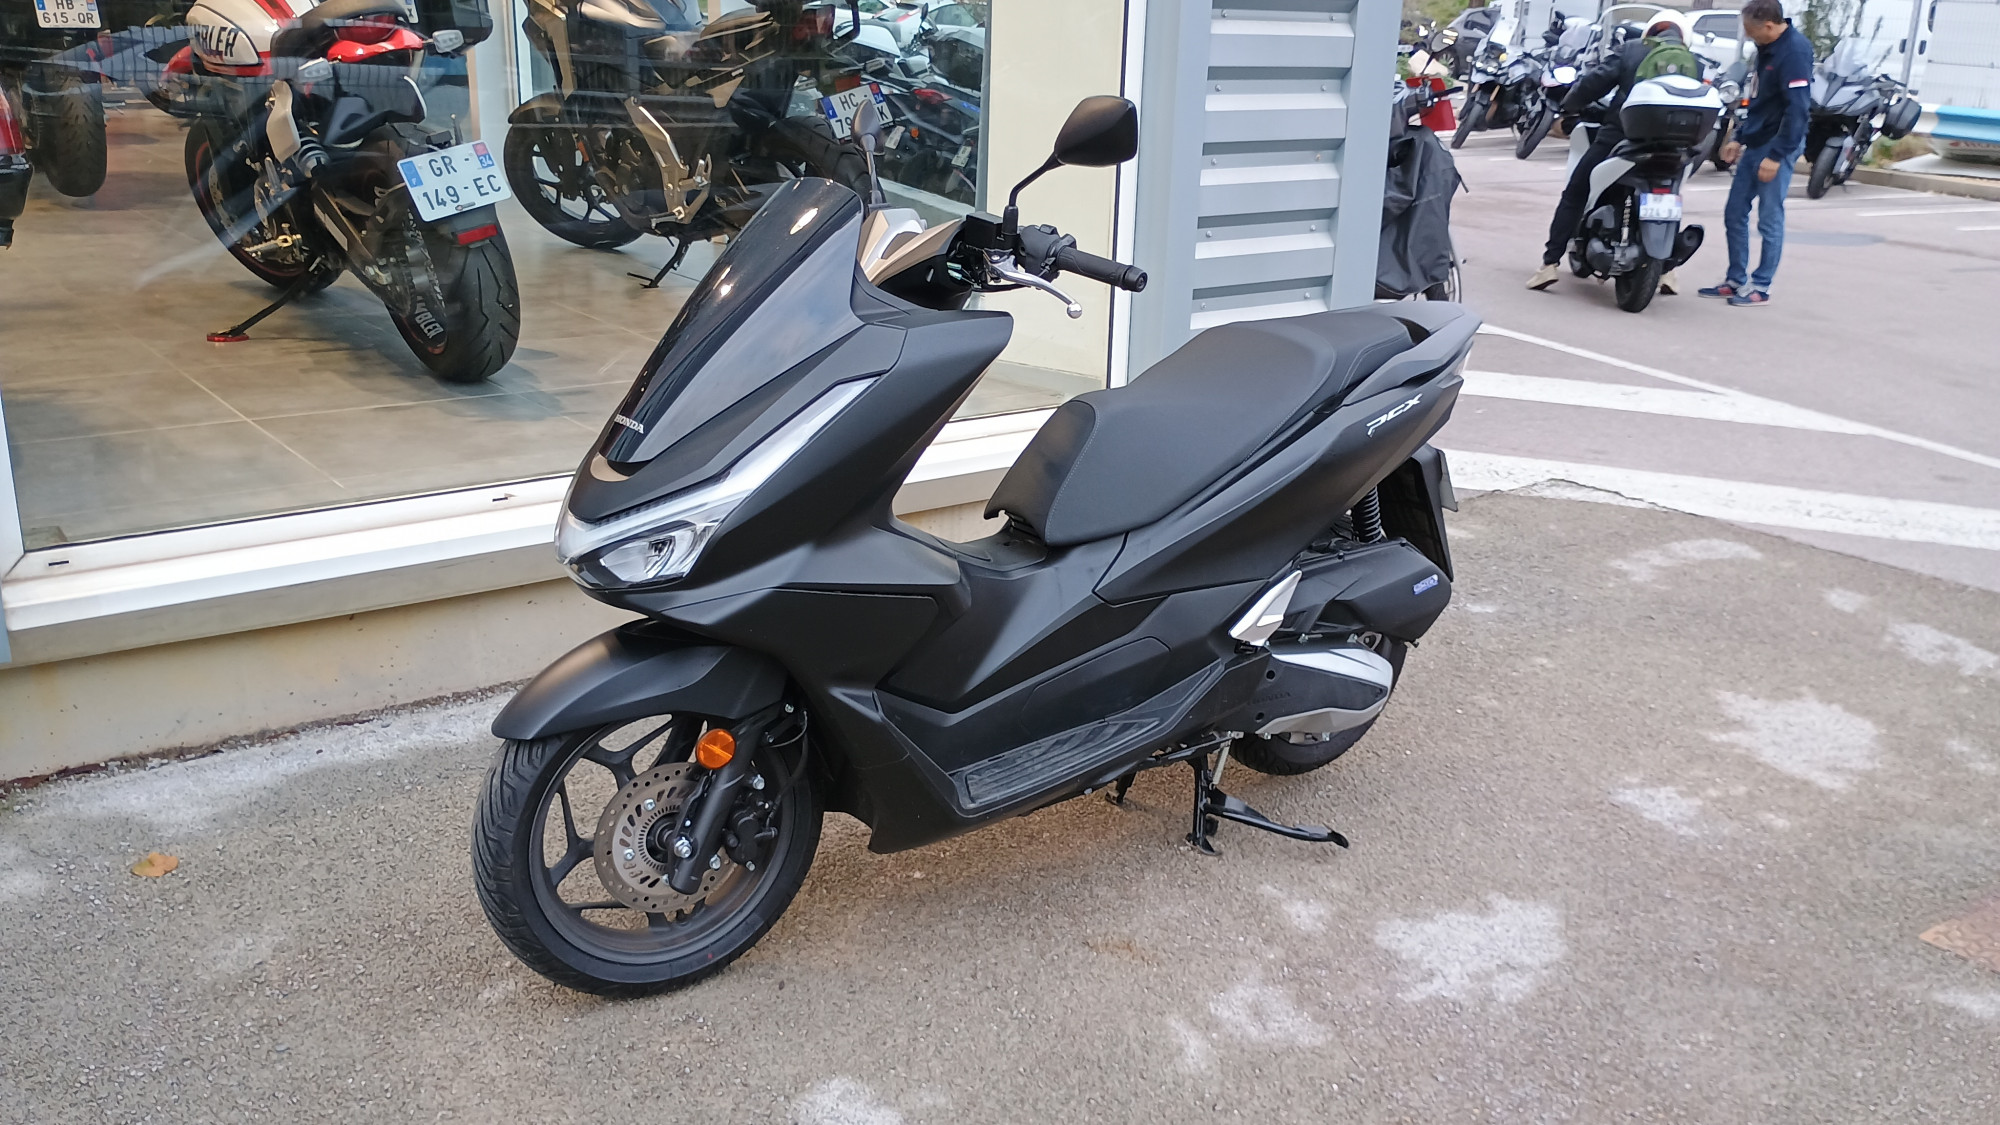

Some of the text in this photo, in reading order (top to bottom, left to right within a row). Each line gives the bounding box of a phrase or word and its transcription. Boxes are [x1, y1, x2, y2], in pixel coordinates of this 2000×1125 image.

[55, 0, 75, 10] HB
[838, 92, 859, 112] HC
[428, 155, 458, 178] GR
[480, 154, 493, 168] 34
[613, 412, 645, 435] HONDA
